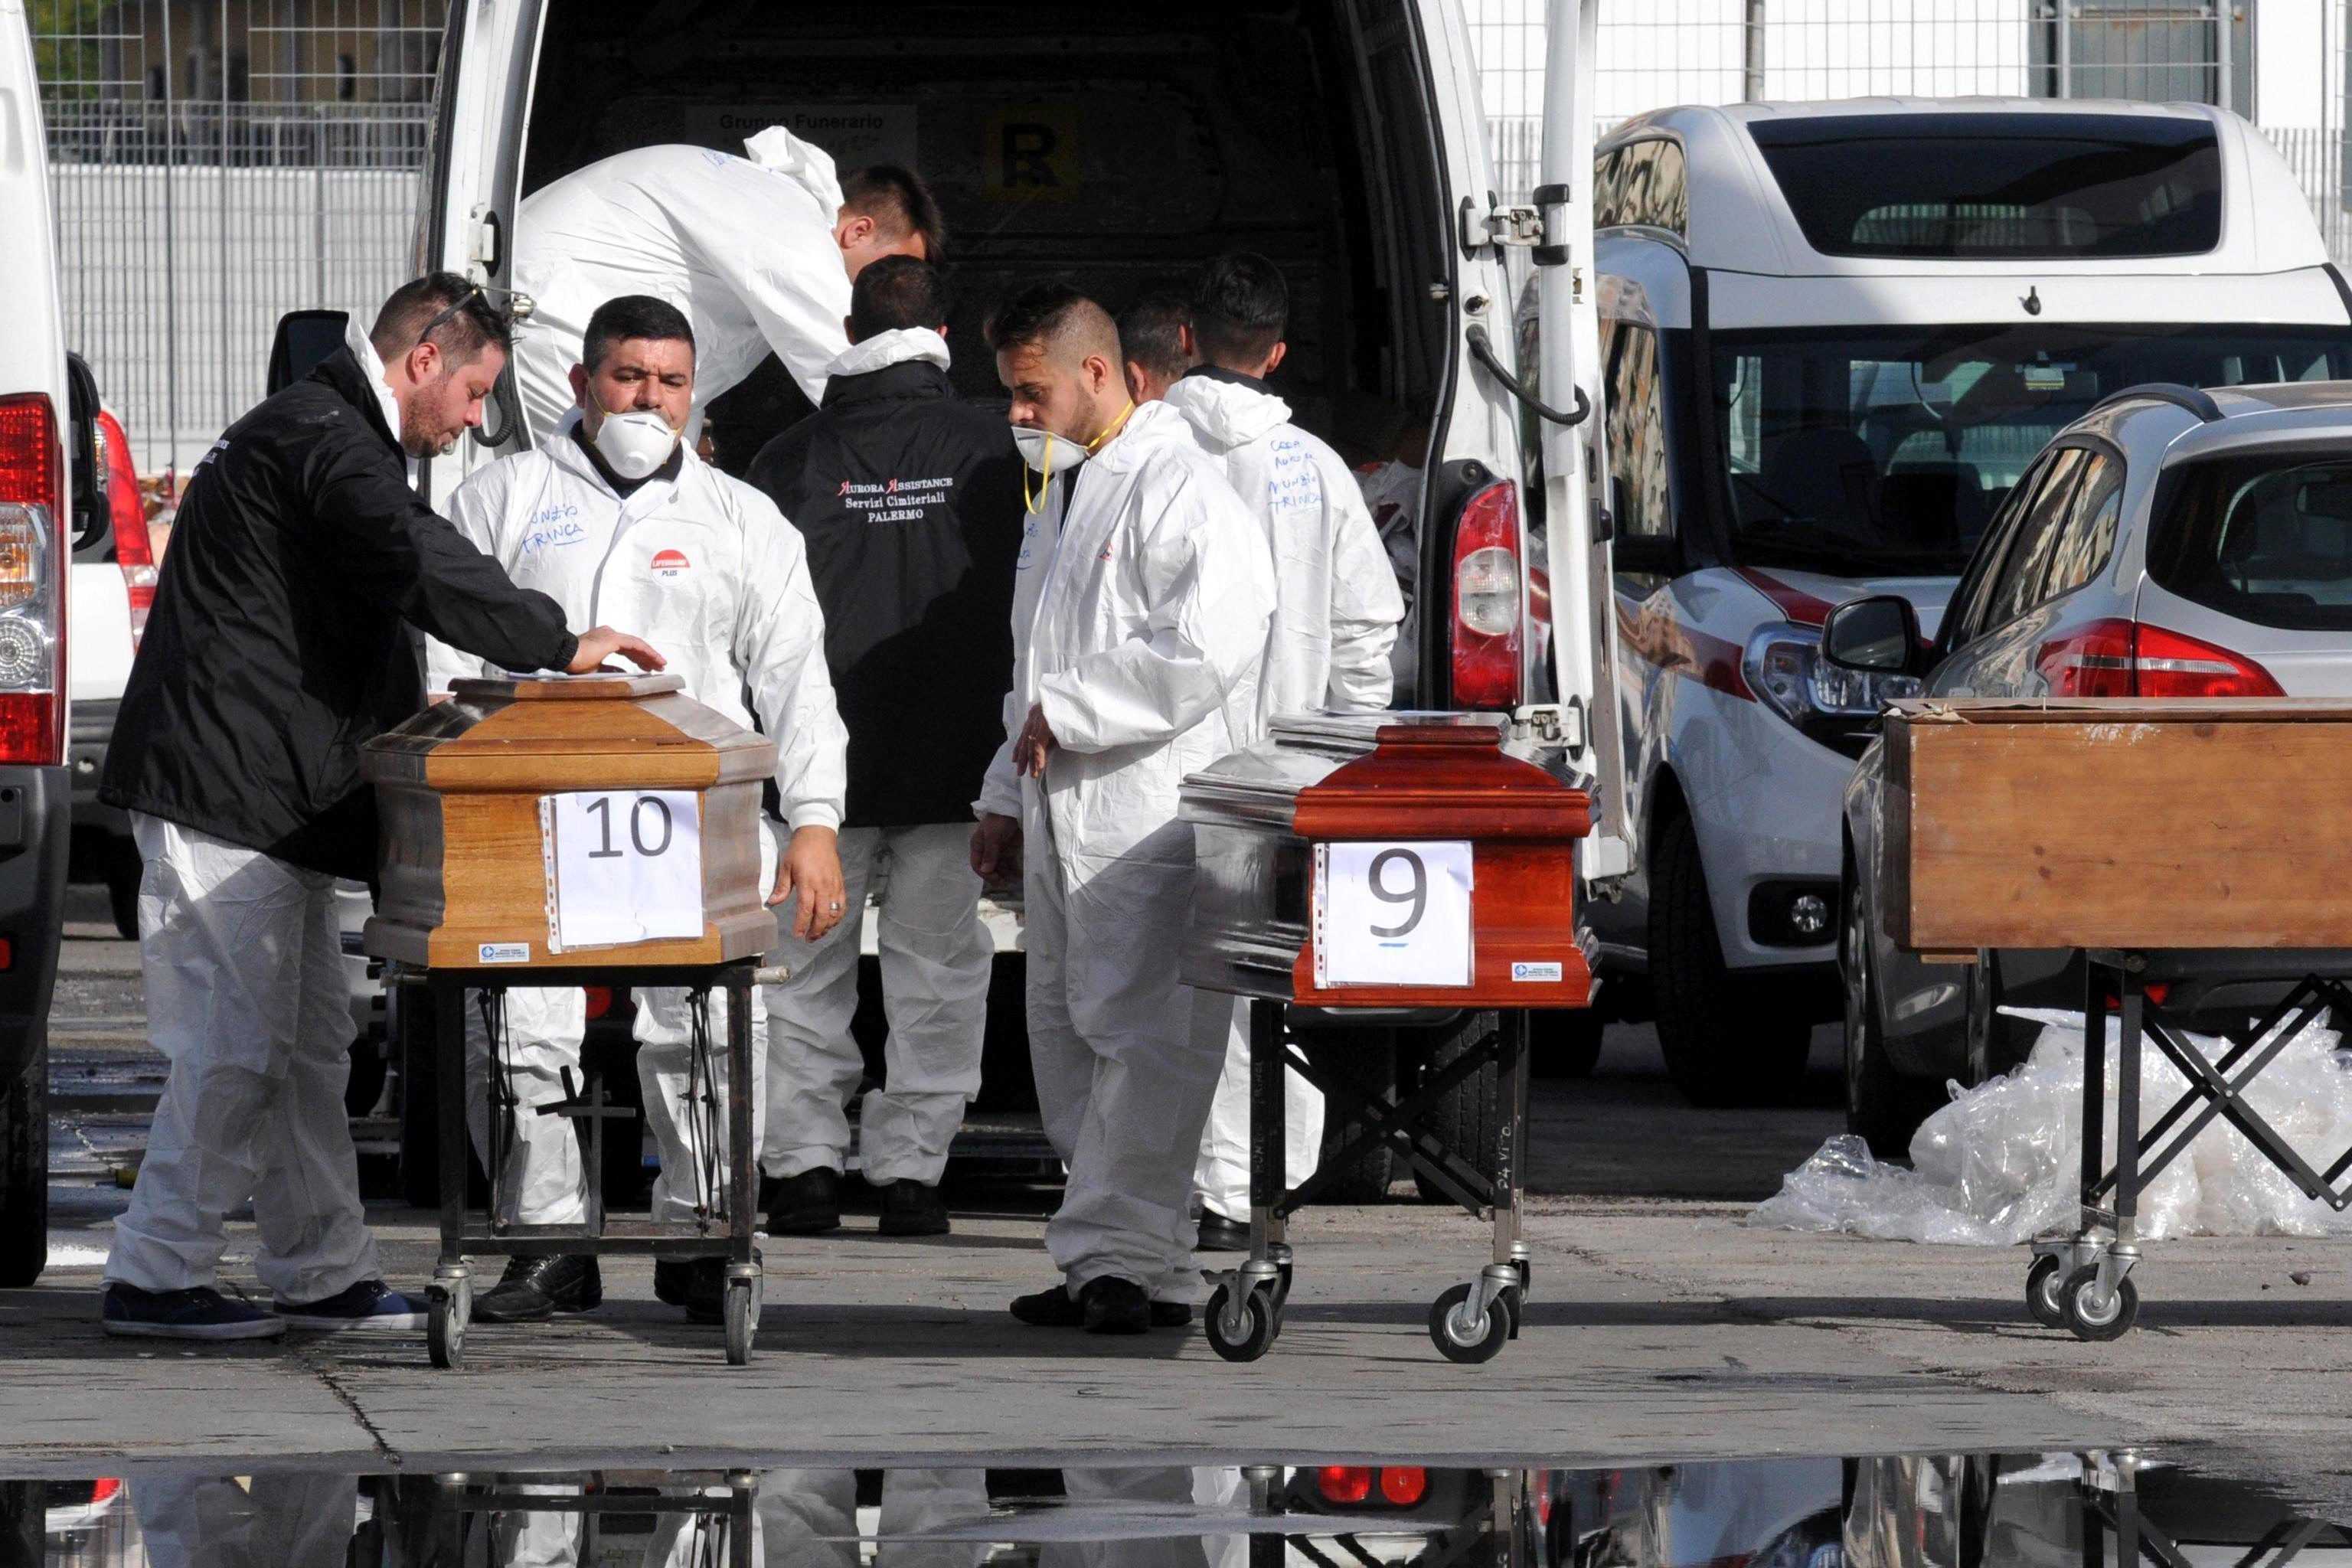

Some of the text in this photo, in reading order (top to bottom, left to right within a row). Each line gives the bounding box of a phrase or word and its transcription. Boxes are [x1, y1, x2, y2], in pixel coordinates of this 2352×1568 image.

[719, 113, 884, 130] Gruppo Funerario
[1003, 122, 1059, 187] R
[837, 477, 954, 496] AURORA ASSISTANCE
[844, 491, 946, 508] Servizi Cimiteriali
[867, 508, 924, 523] PALERMO
[586, 795, 673, 859] 10
[1367, 847, 1428, 939] 9
